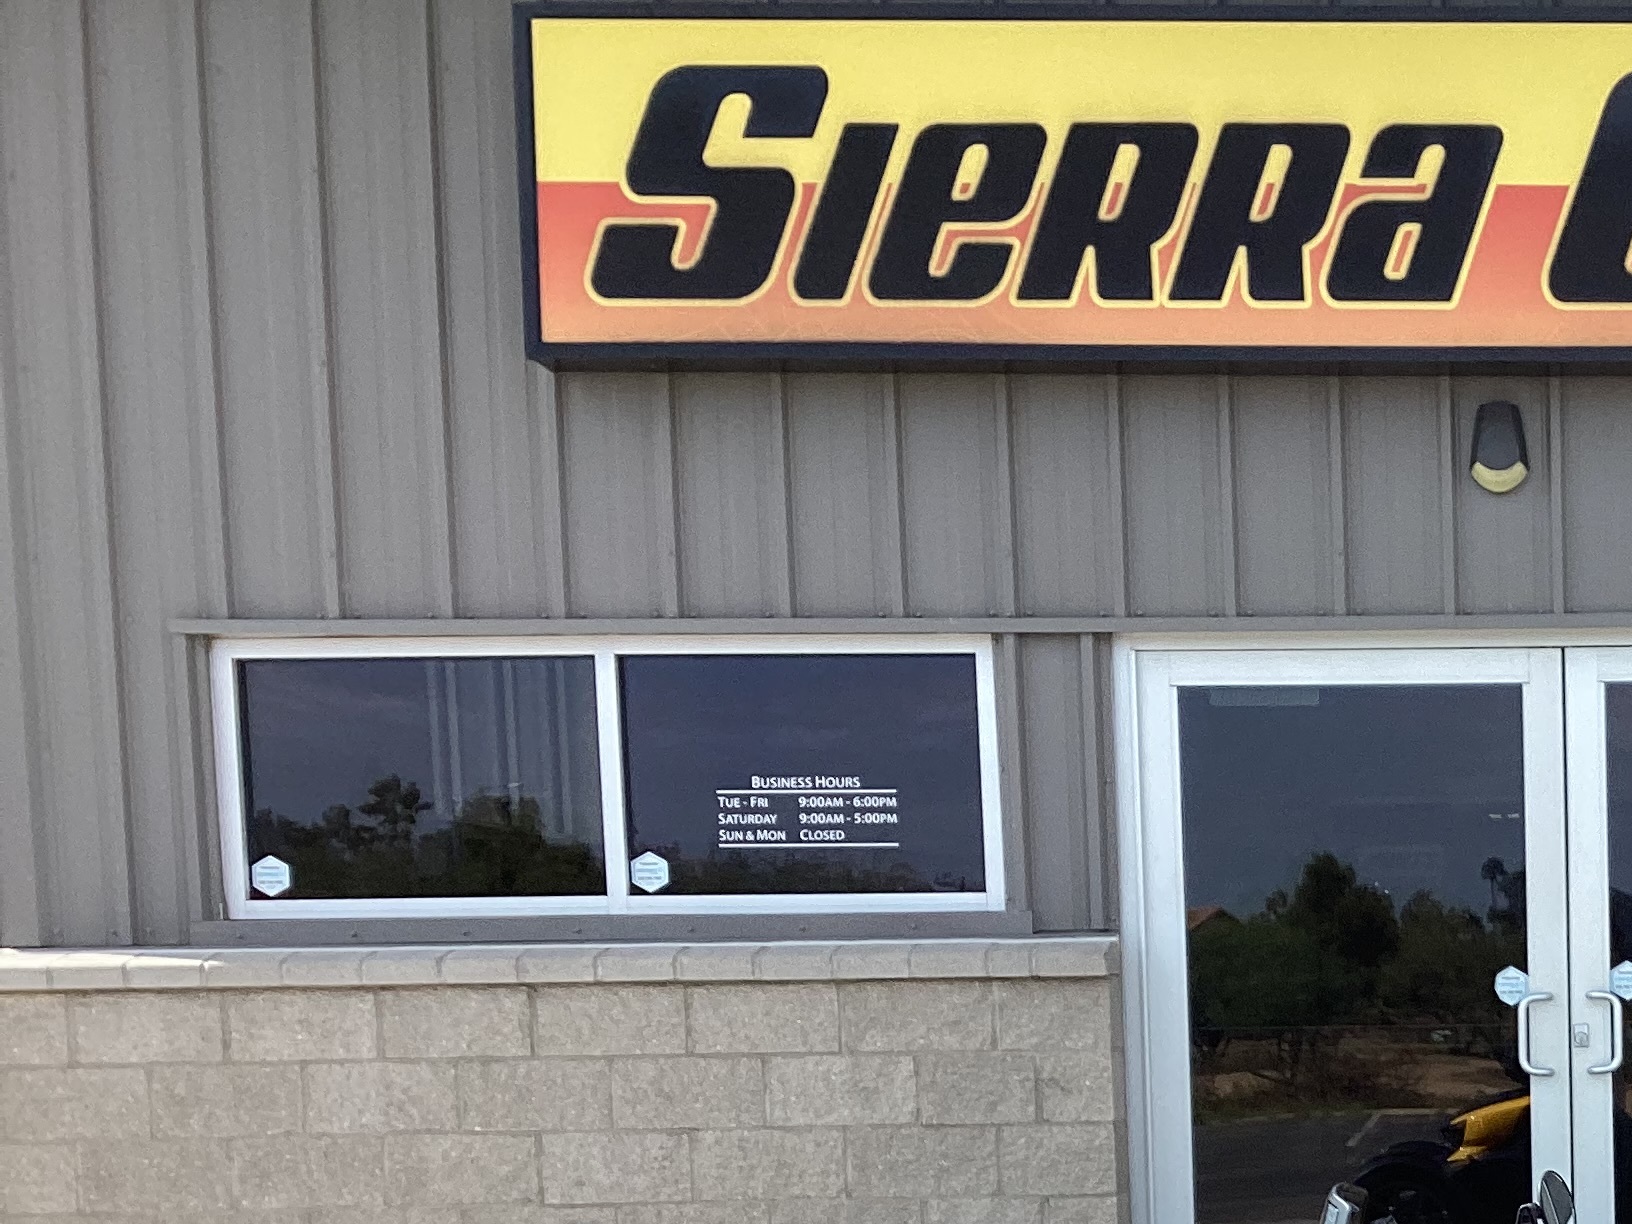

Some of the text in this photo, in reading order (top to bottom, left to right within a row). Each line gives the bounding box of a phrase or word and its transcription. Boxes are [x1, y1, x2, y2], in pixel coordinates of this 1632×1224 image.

[751, 775, 861, 789] BUSINESS HOURS
[717, 796, 741, 808] TUE
[750, 796, 769, 808] FRI
[798, 796, 844, 808] 9:00AM
[852, 796, 898, 807] 6:00PM
[718, 813, 777, 825] SATURDAY
[799, 813, 845, 824] 9:00AM
[853, 813, 898, 824] 5:00PM
[718, 829, 846, 841] SUN & MON CLOSED
